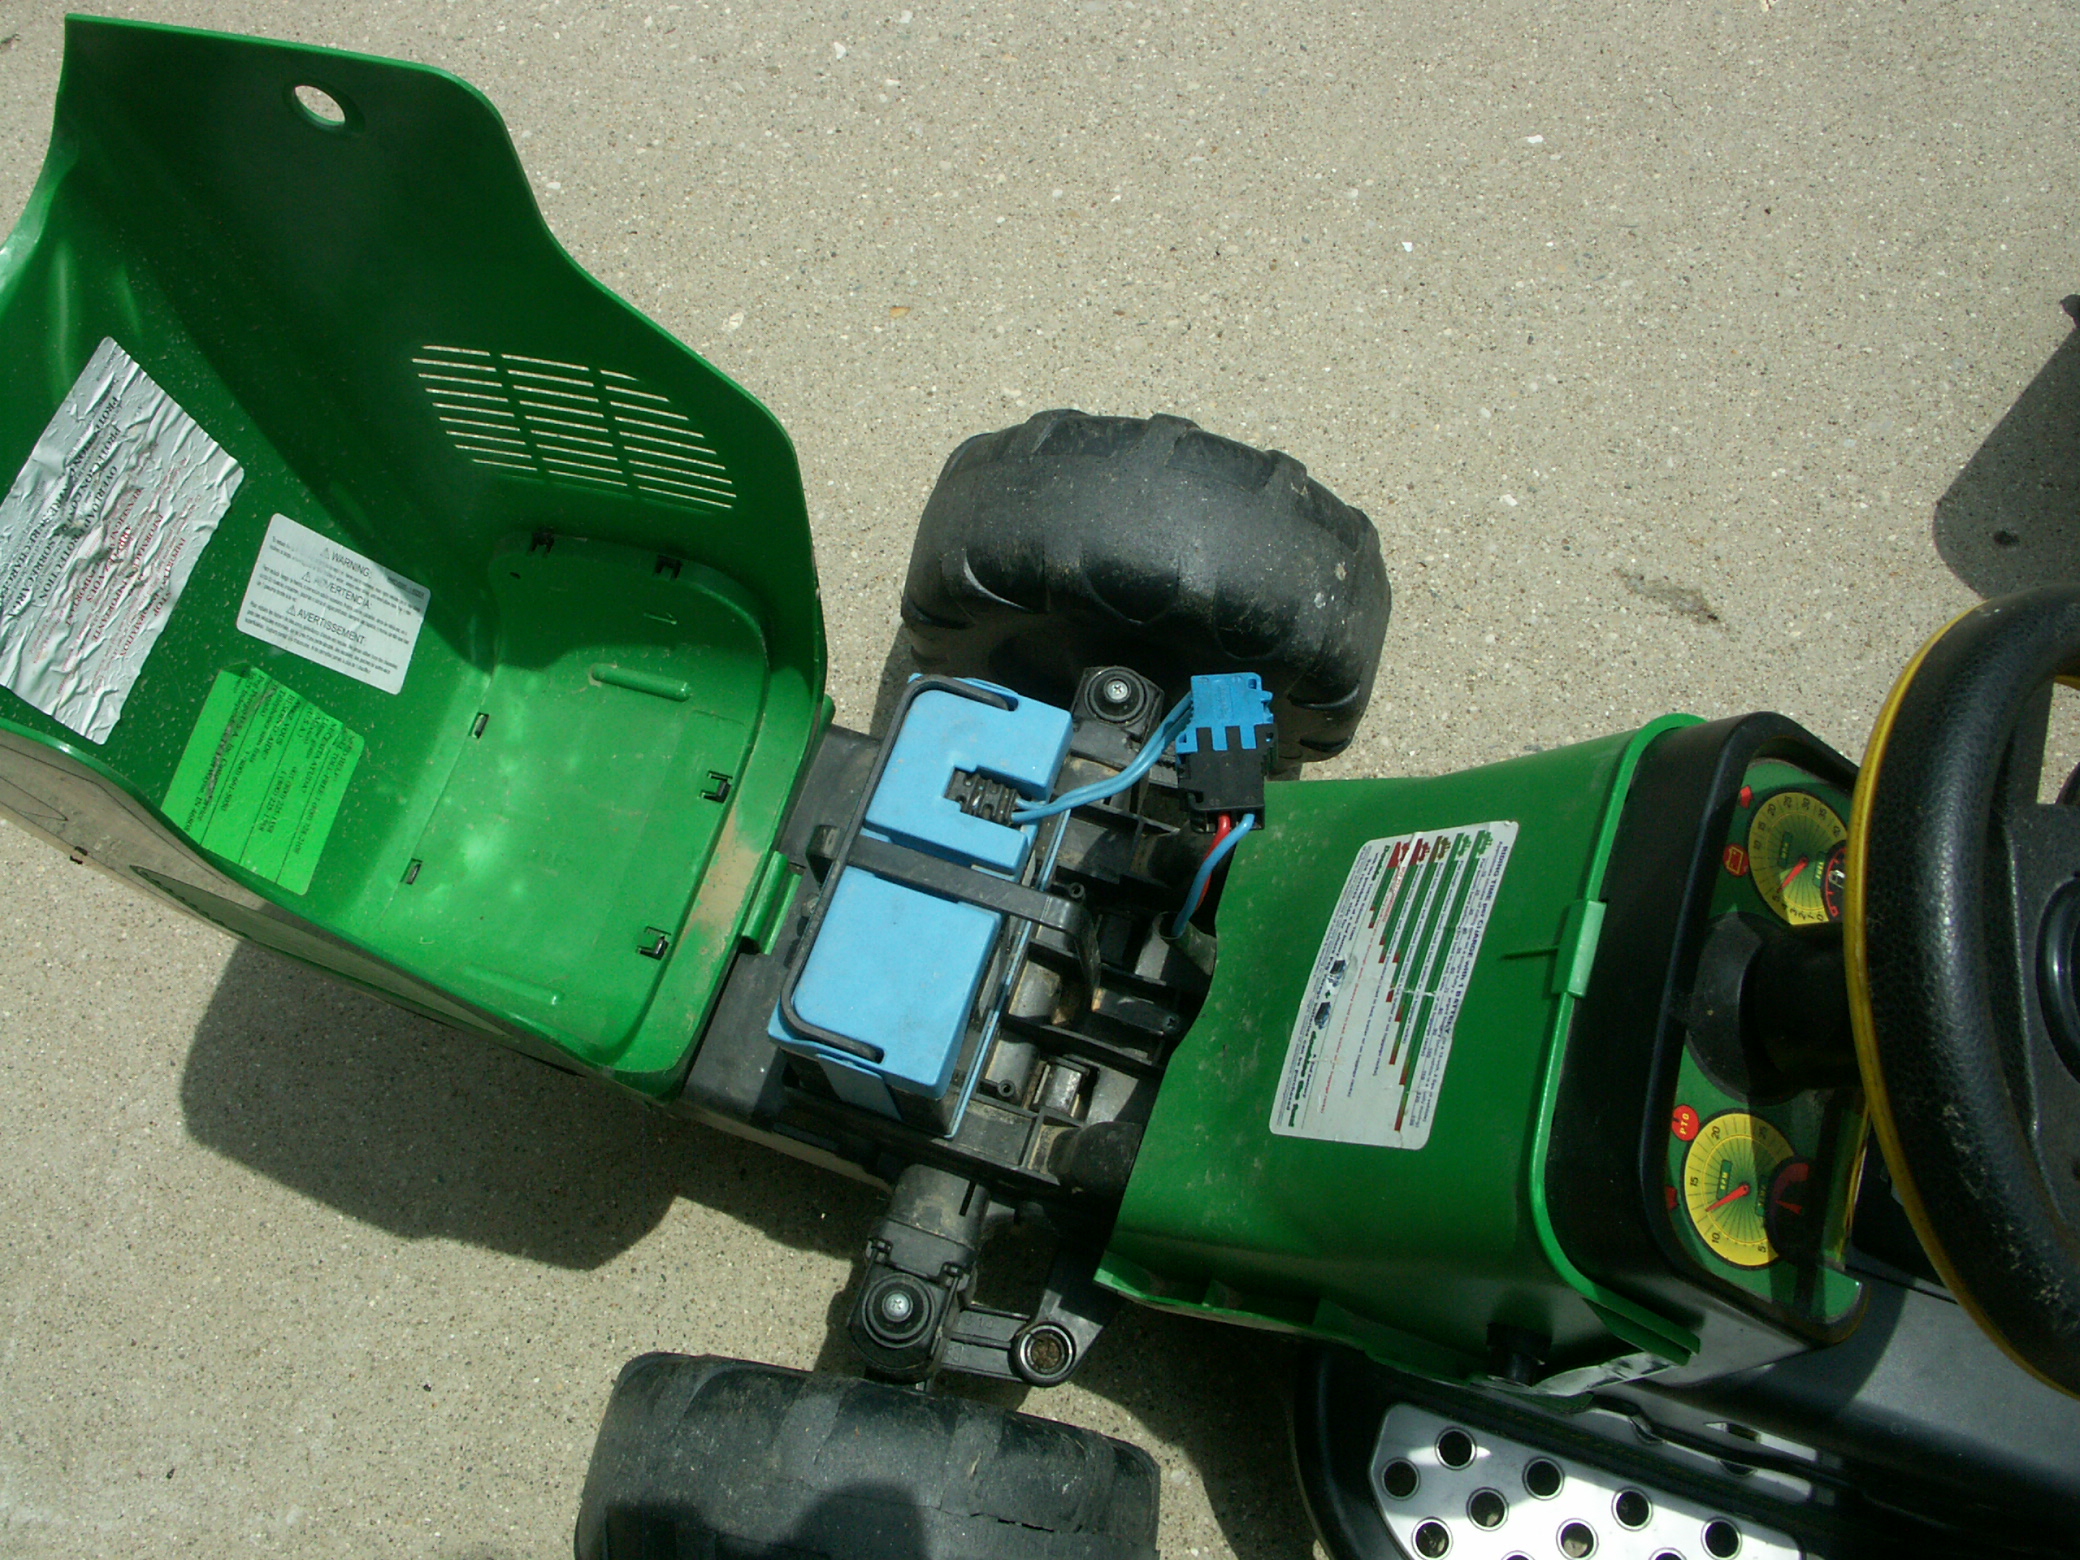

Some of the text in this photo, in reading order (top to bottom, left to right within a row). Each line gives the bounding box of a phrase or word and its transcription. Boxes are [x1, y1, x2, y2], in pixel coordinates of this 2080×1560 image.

[81, 462, 119, 531] OVERLOAD
[37, 526, 85, 602] PROTECTION
[329, 550, 373, 580] WARNING:
[84, 571, 105, 604] VOUS
[150, 589, 172, 618] STOP
[295, 606, 367, 646] AVERTISSEMENT:
[1767, 803, 1777, 816] 20
[1783, 796, 1793, 808] 25
[1801, 797, 1811, 810] 30
[1818, 807, 1827, 820] 35
[1492, 845, 1509, 877] RIDING
[1484, 878, 1498, 901] TIME
[1344, 901, 1354, 917] side
[1478, 902, 1490, 919] per
[1790, 908, 1798, 916] 3
[1339, 918, 1348, 929] for
[1324, 956, 1334, 970] Peg
[1459, 959, 1472, 980] with
[1443, 990, 1463, 1034] BATTERY
[1295, 1056, 1303, 1066] be
[1285, 1068, 1299, 1110] purchased
[1293, 1079, 1305, 1100] the
[1679, 1112, 1690, 1136] PTO
[1710, 1125, 1721, 1140] 20
[1689, 1175, 1699, 1187] 15
[1720, 1171, 1730, 1191] RPM
[1711, 1232, 1721, 1244] 10
[1758, 1244, 1767, 1253] 5
